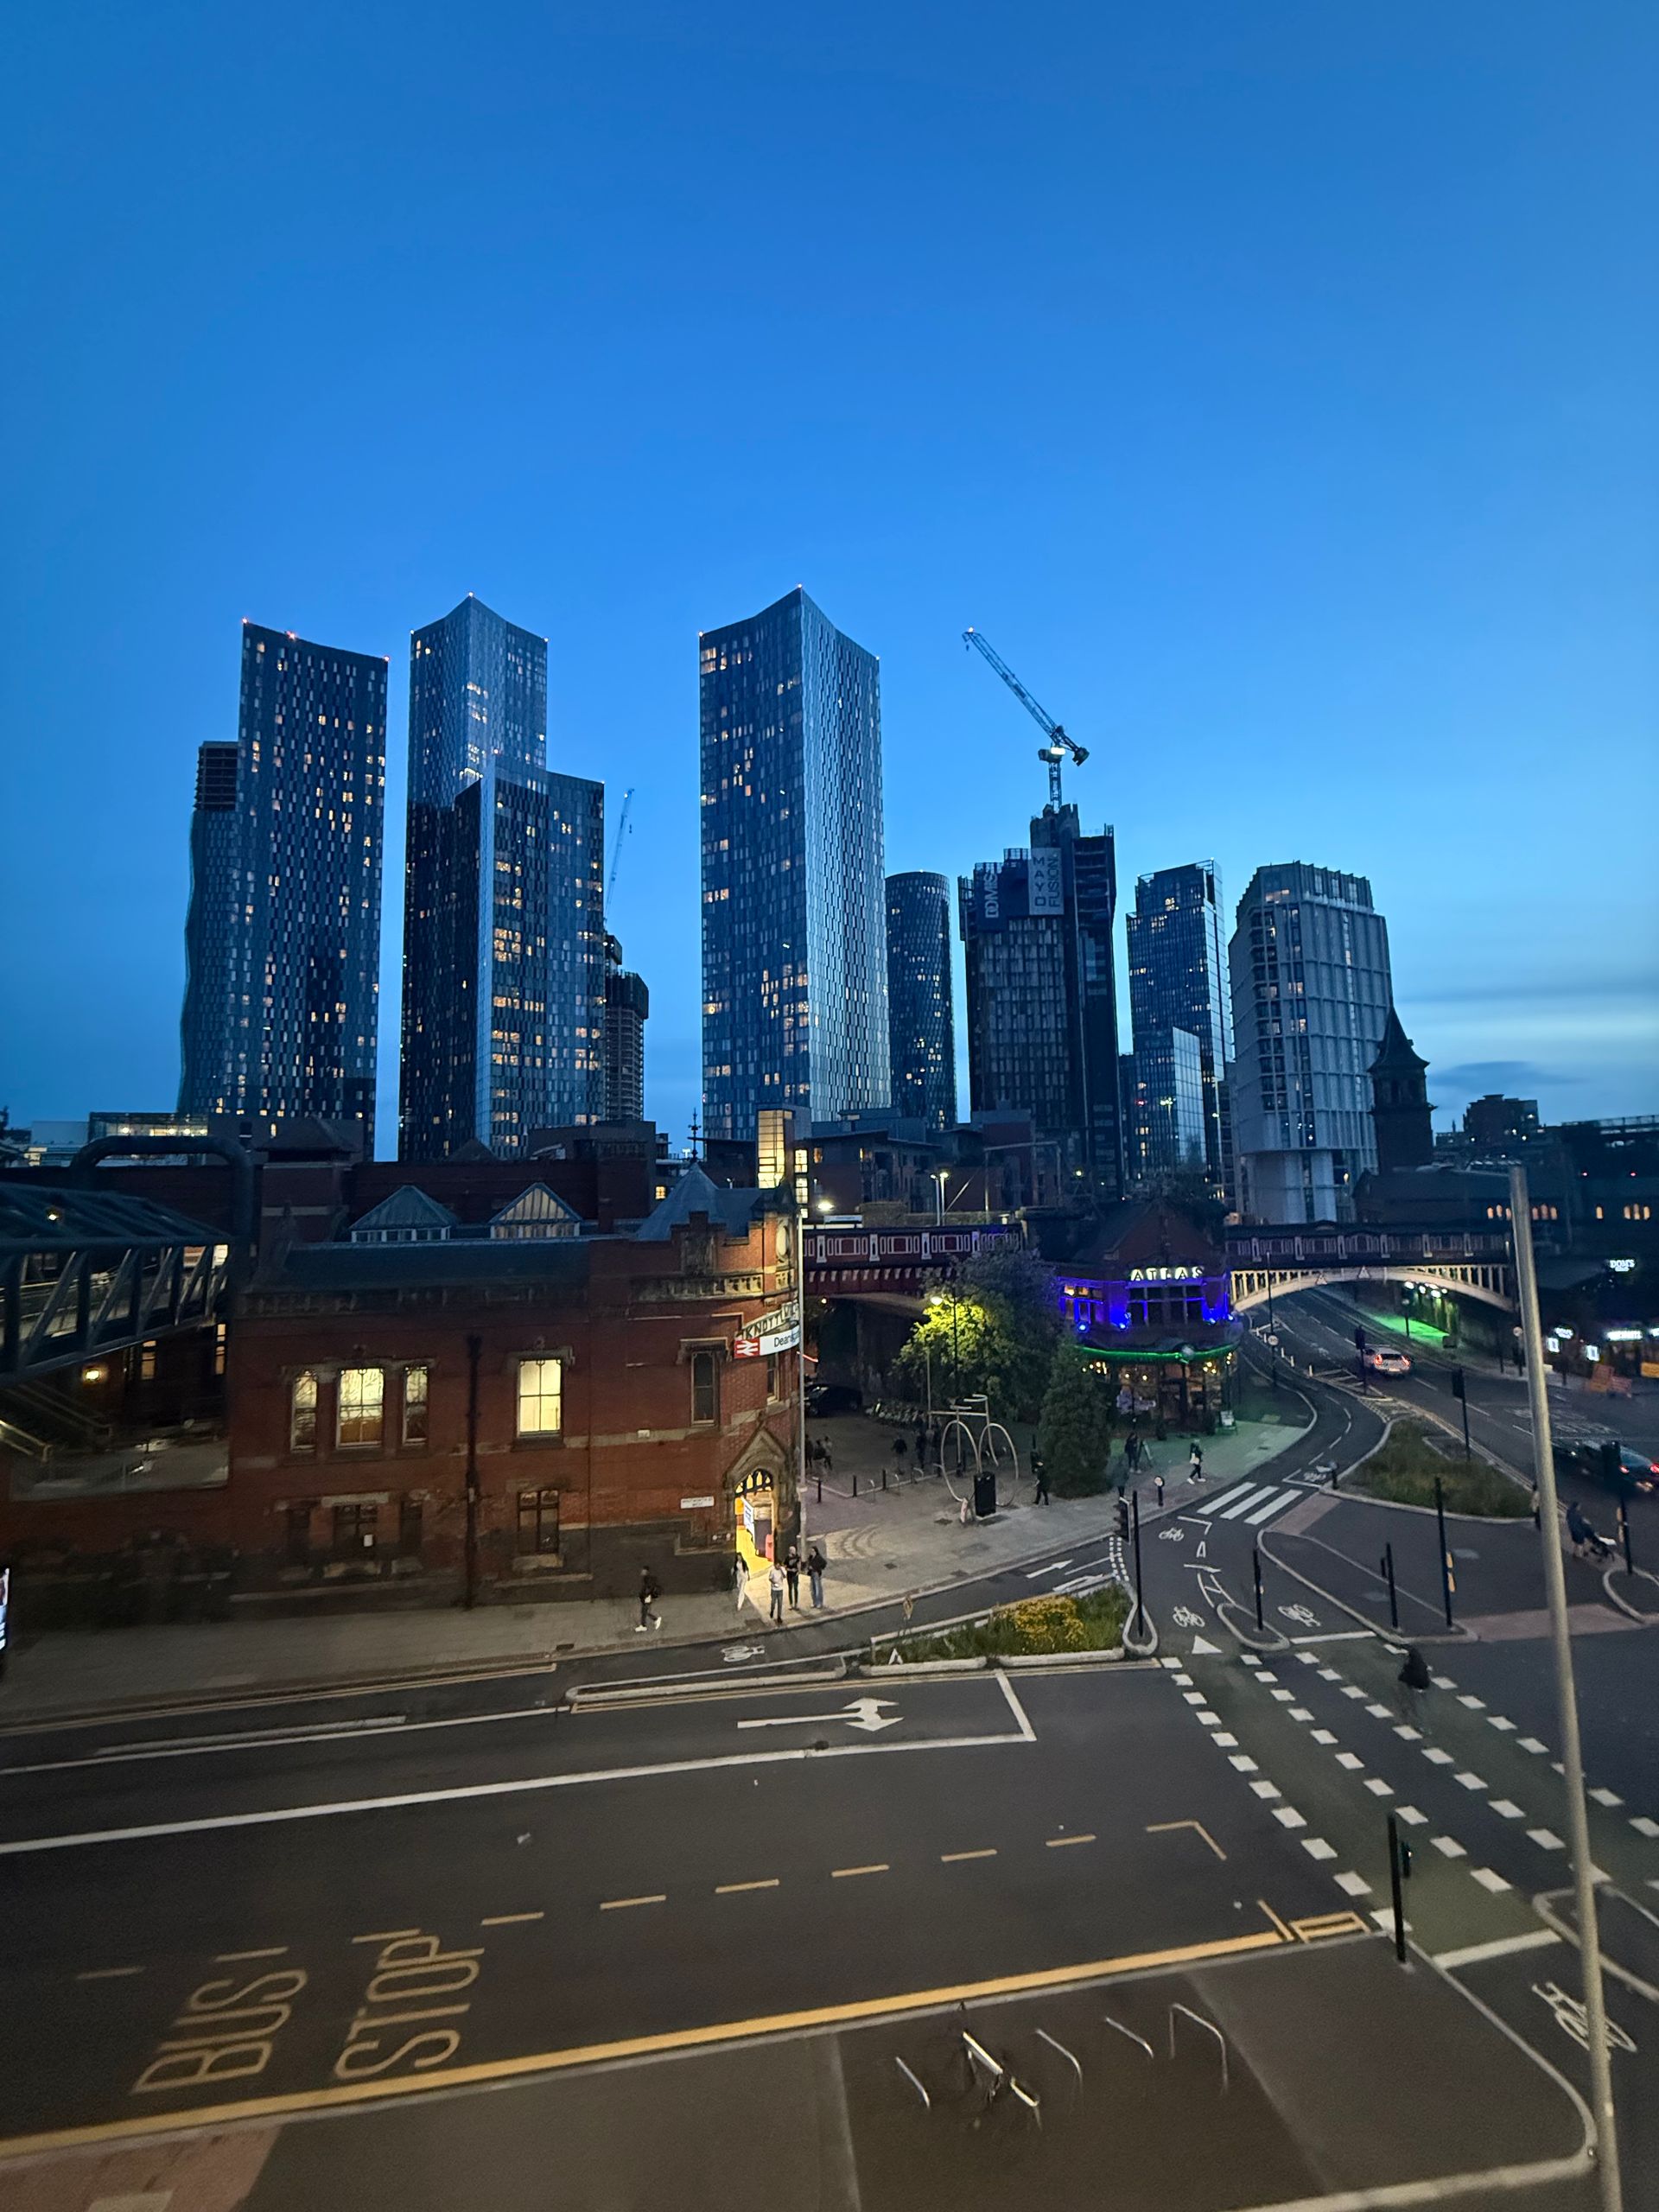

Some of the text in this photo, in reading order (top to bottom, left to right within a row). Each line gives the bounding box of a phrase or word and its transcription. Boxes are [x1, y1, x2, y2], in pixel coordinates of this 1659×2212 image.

[1047, 857, 1060, 907] FUSION
[1130, 1266, 1205, 1281] ATLAS
[133, 1969, 307, 2093] BUS
[335, 1936, 485, 2079] STOP
